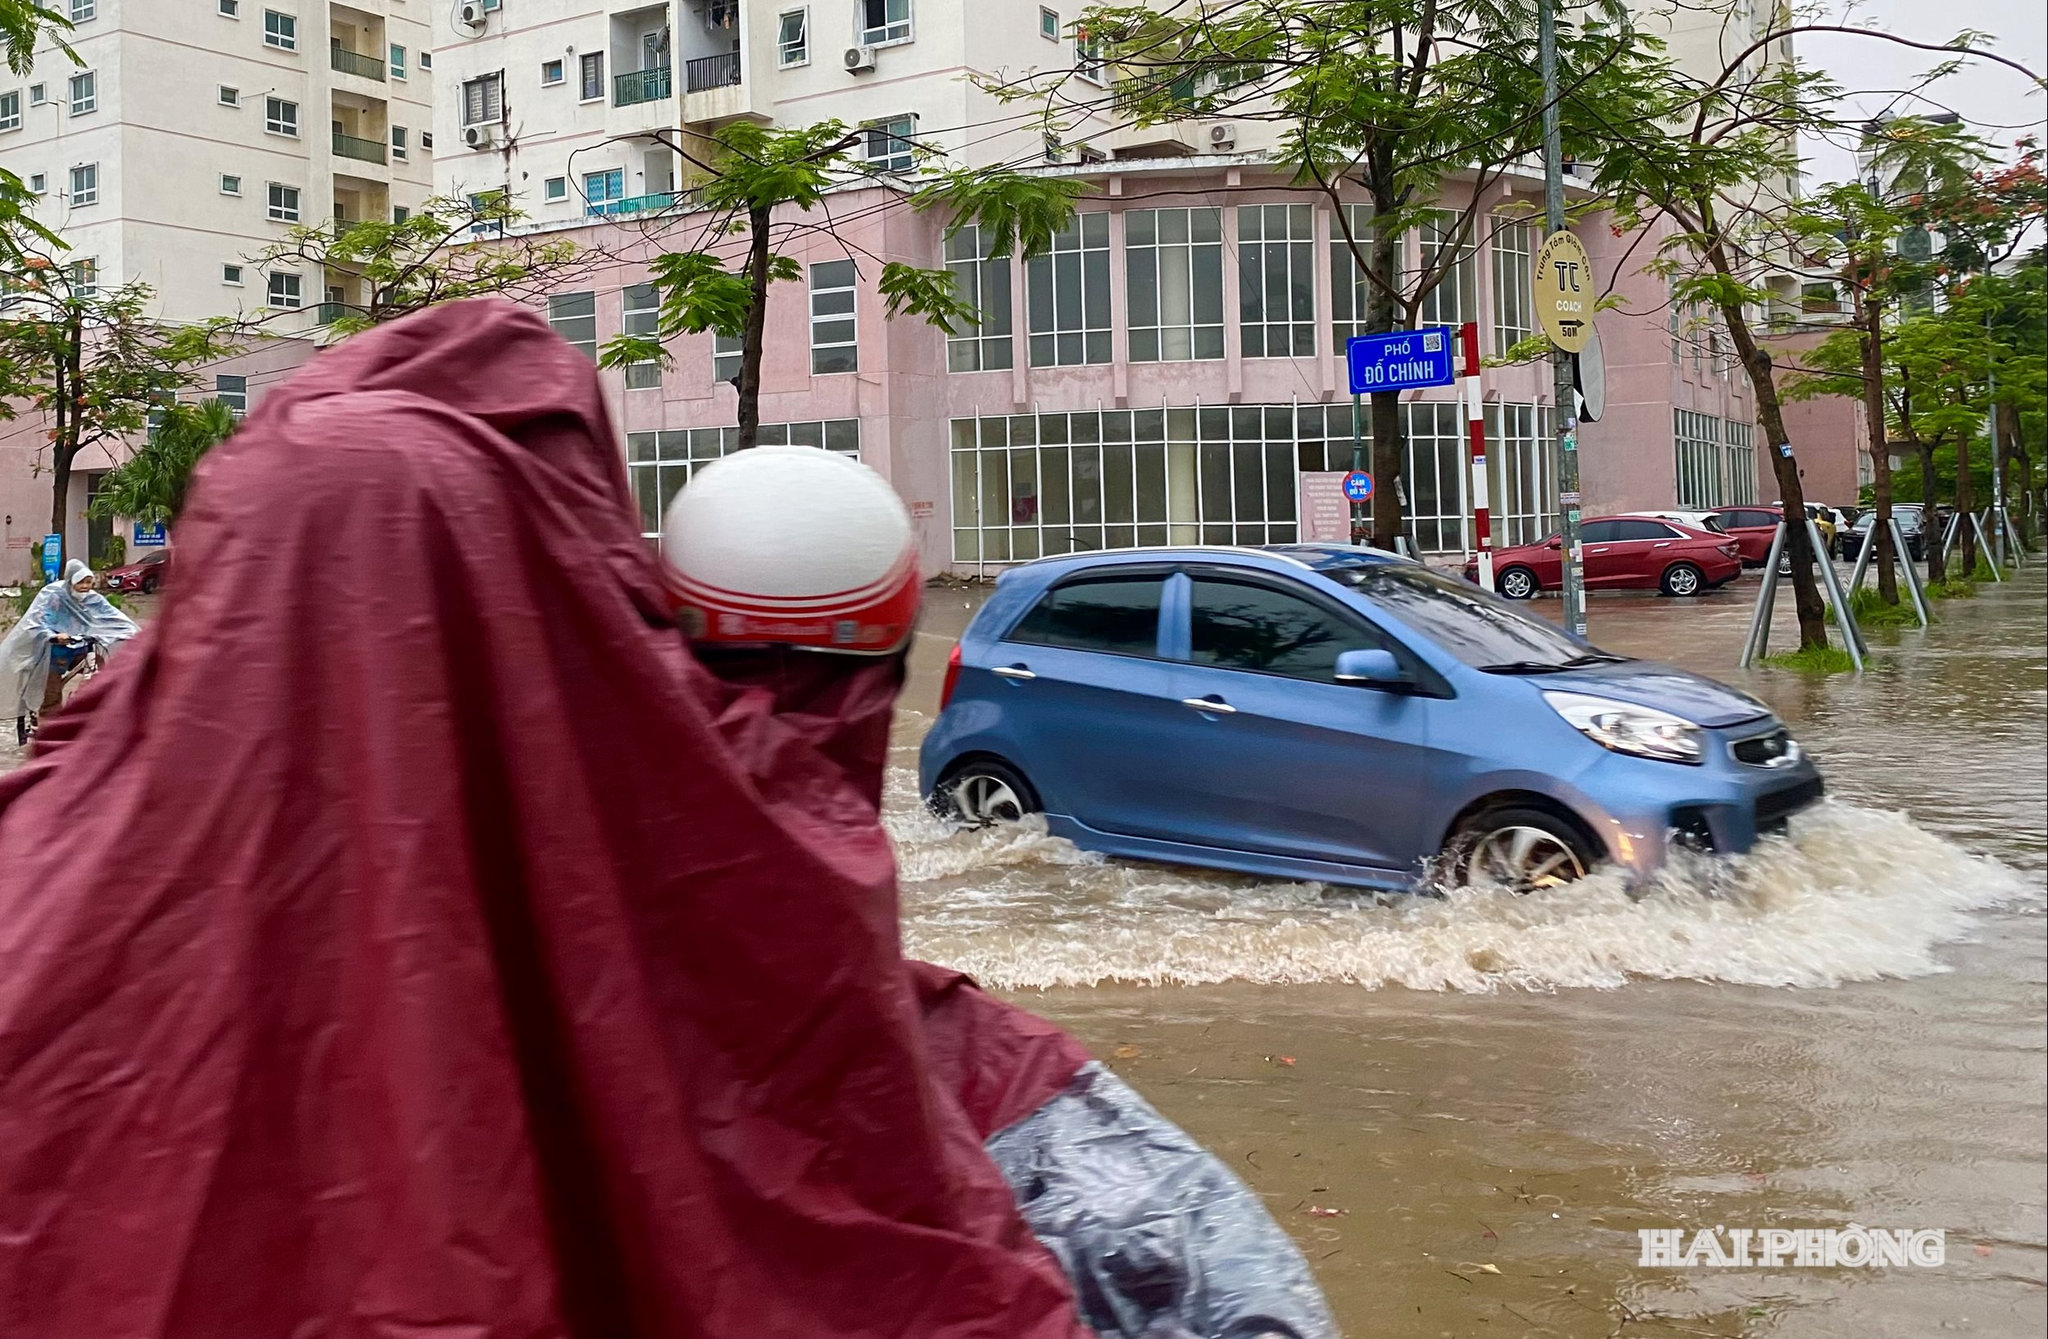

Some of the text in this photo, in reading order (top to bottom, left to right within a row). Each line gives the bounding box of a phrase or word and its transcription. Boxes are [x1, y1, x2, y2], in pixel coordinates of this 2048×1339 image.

[1536, 248, 1551, 281] Trung
[1554, 261, 1580, 292] TC
[1556, 300, 1582, 313] COACH
[1384, 337, 1411, 357] PHỐ
[1364, 357, 1434, 385] ĐỖ CHÍNH
